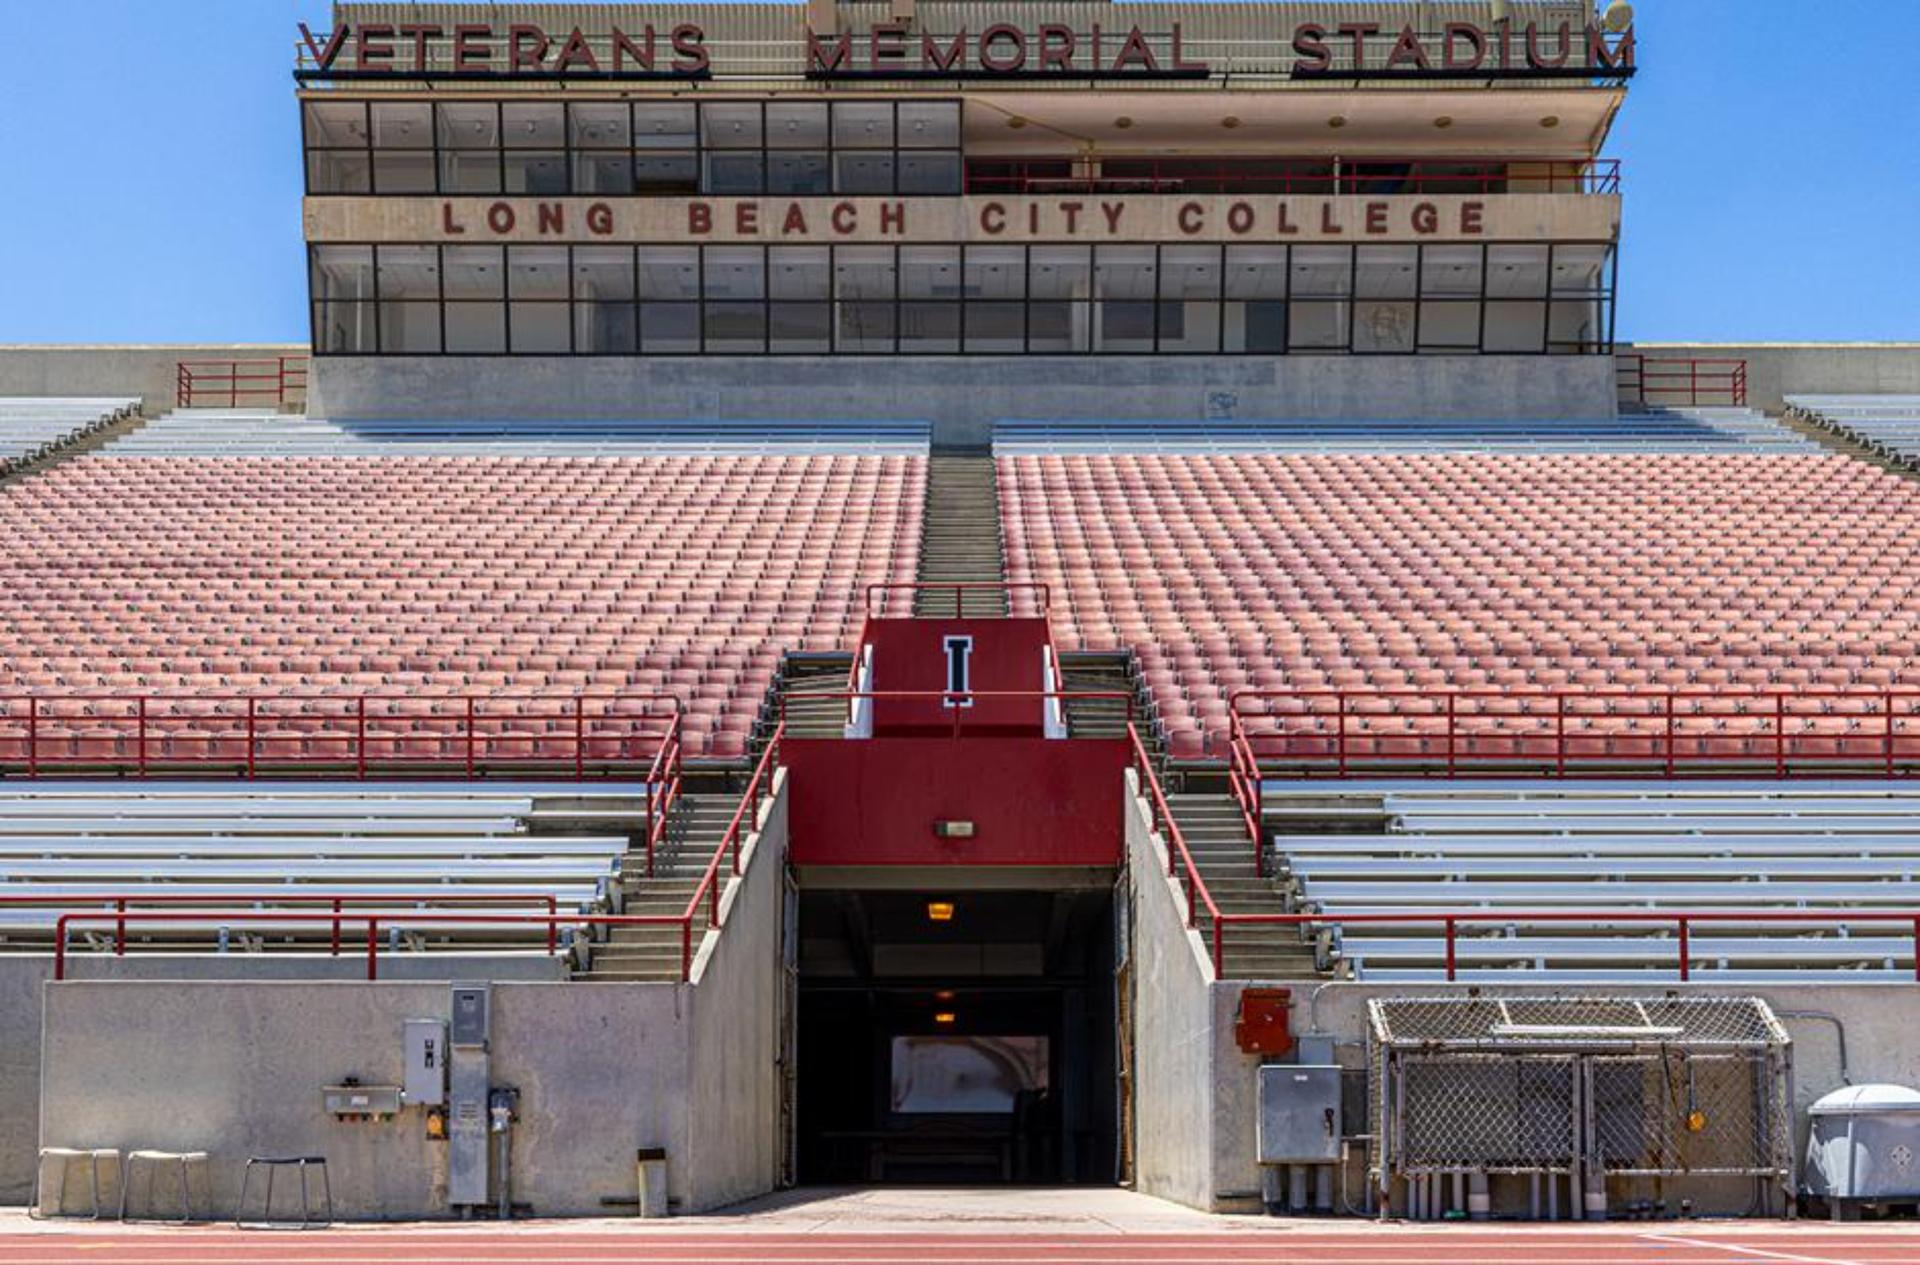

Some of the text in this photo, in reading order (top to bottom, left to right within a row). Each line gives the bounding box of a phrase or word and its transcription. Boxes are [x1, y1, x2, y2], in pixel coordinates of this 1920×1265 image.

[299, 23, 1636, 71] VETERANS MEMORIAL STADIUM
[444, 202, 1484, 234] LONG BEACH CITY COLLEGE
